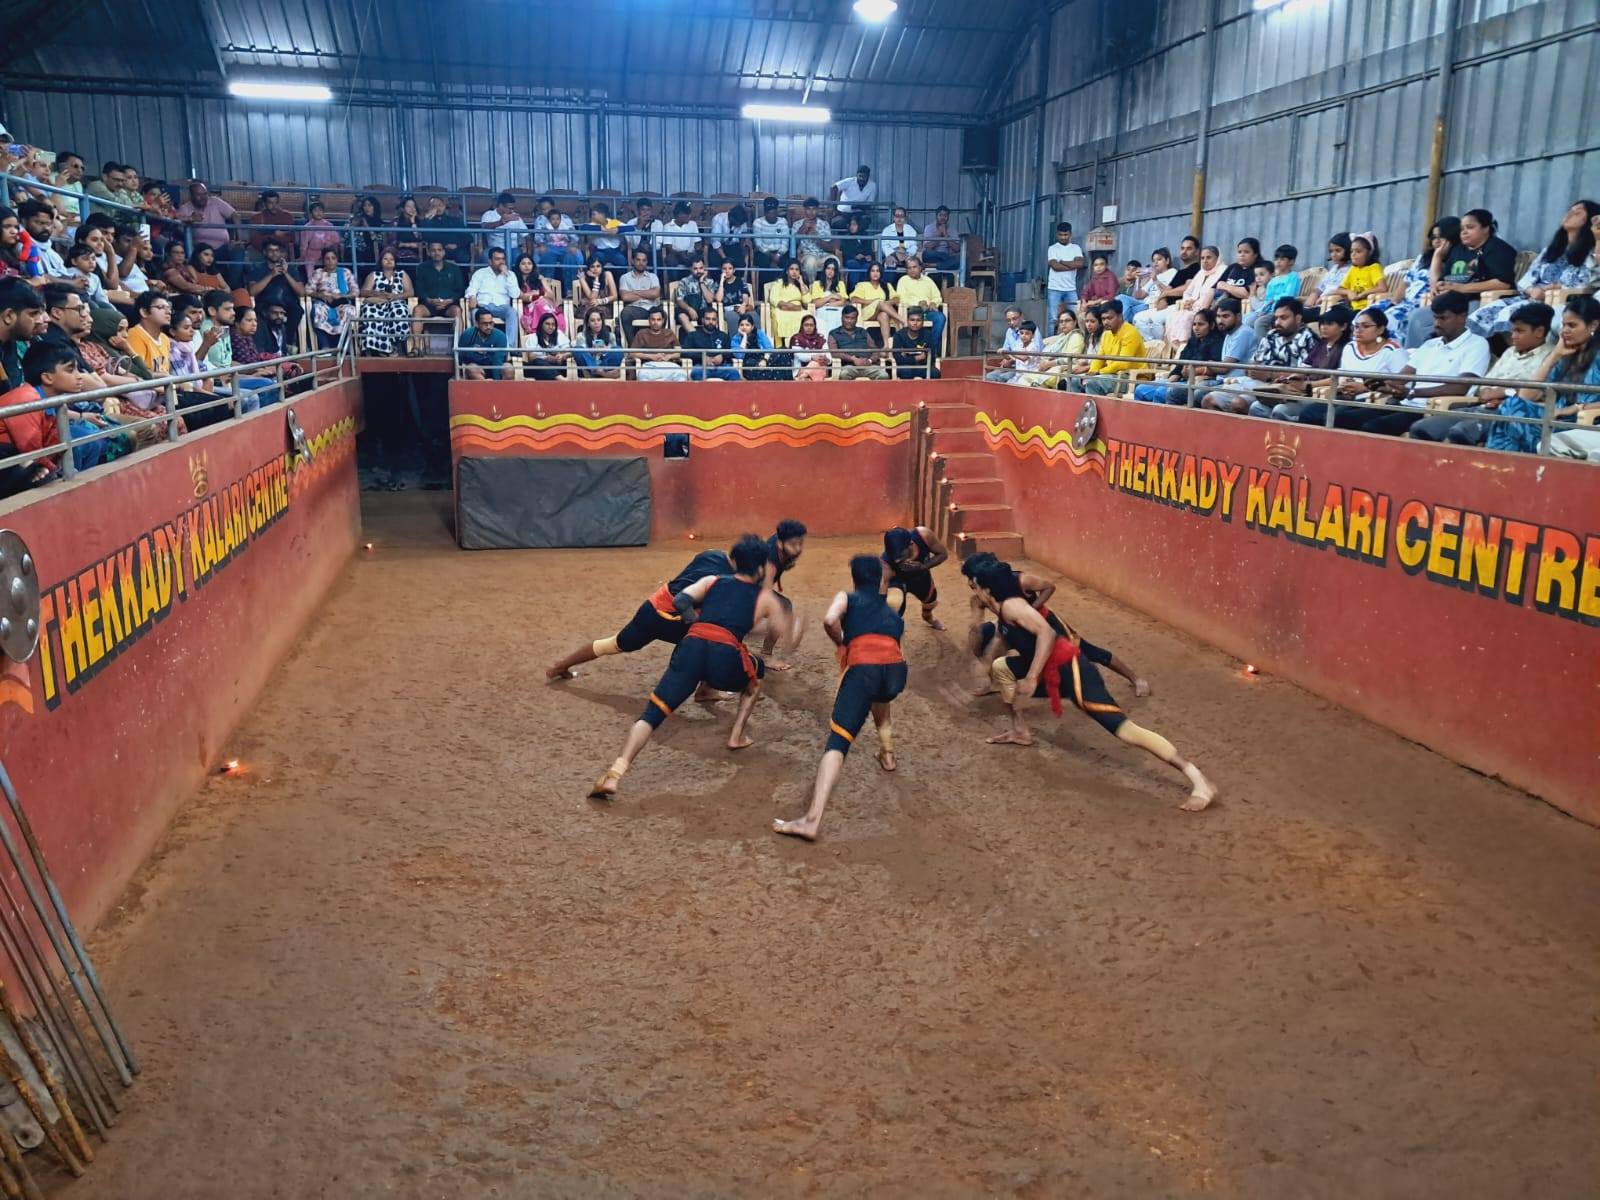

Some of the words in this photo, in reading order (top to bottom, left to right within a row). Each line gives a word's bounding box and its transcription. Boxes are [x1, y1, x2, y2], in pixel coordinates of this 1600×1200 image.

[39, 514, 187, 707] THEKKADY
[187, 479, 248, 585] KALARI
[245, 453, 288, 537] CENTRE
[1106, 439, 1242, 519] THEKKADY
[1245, 467, 1391, 563] KALARI
